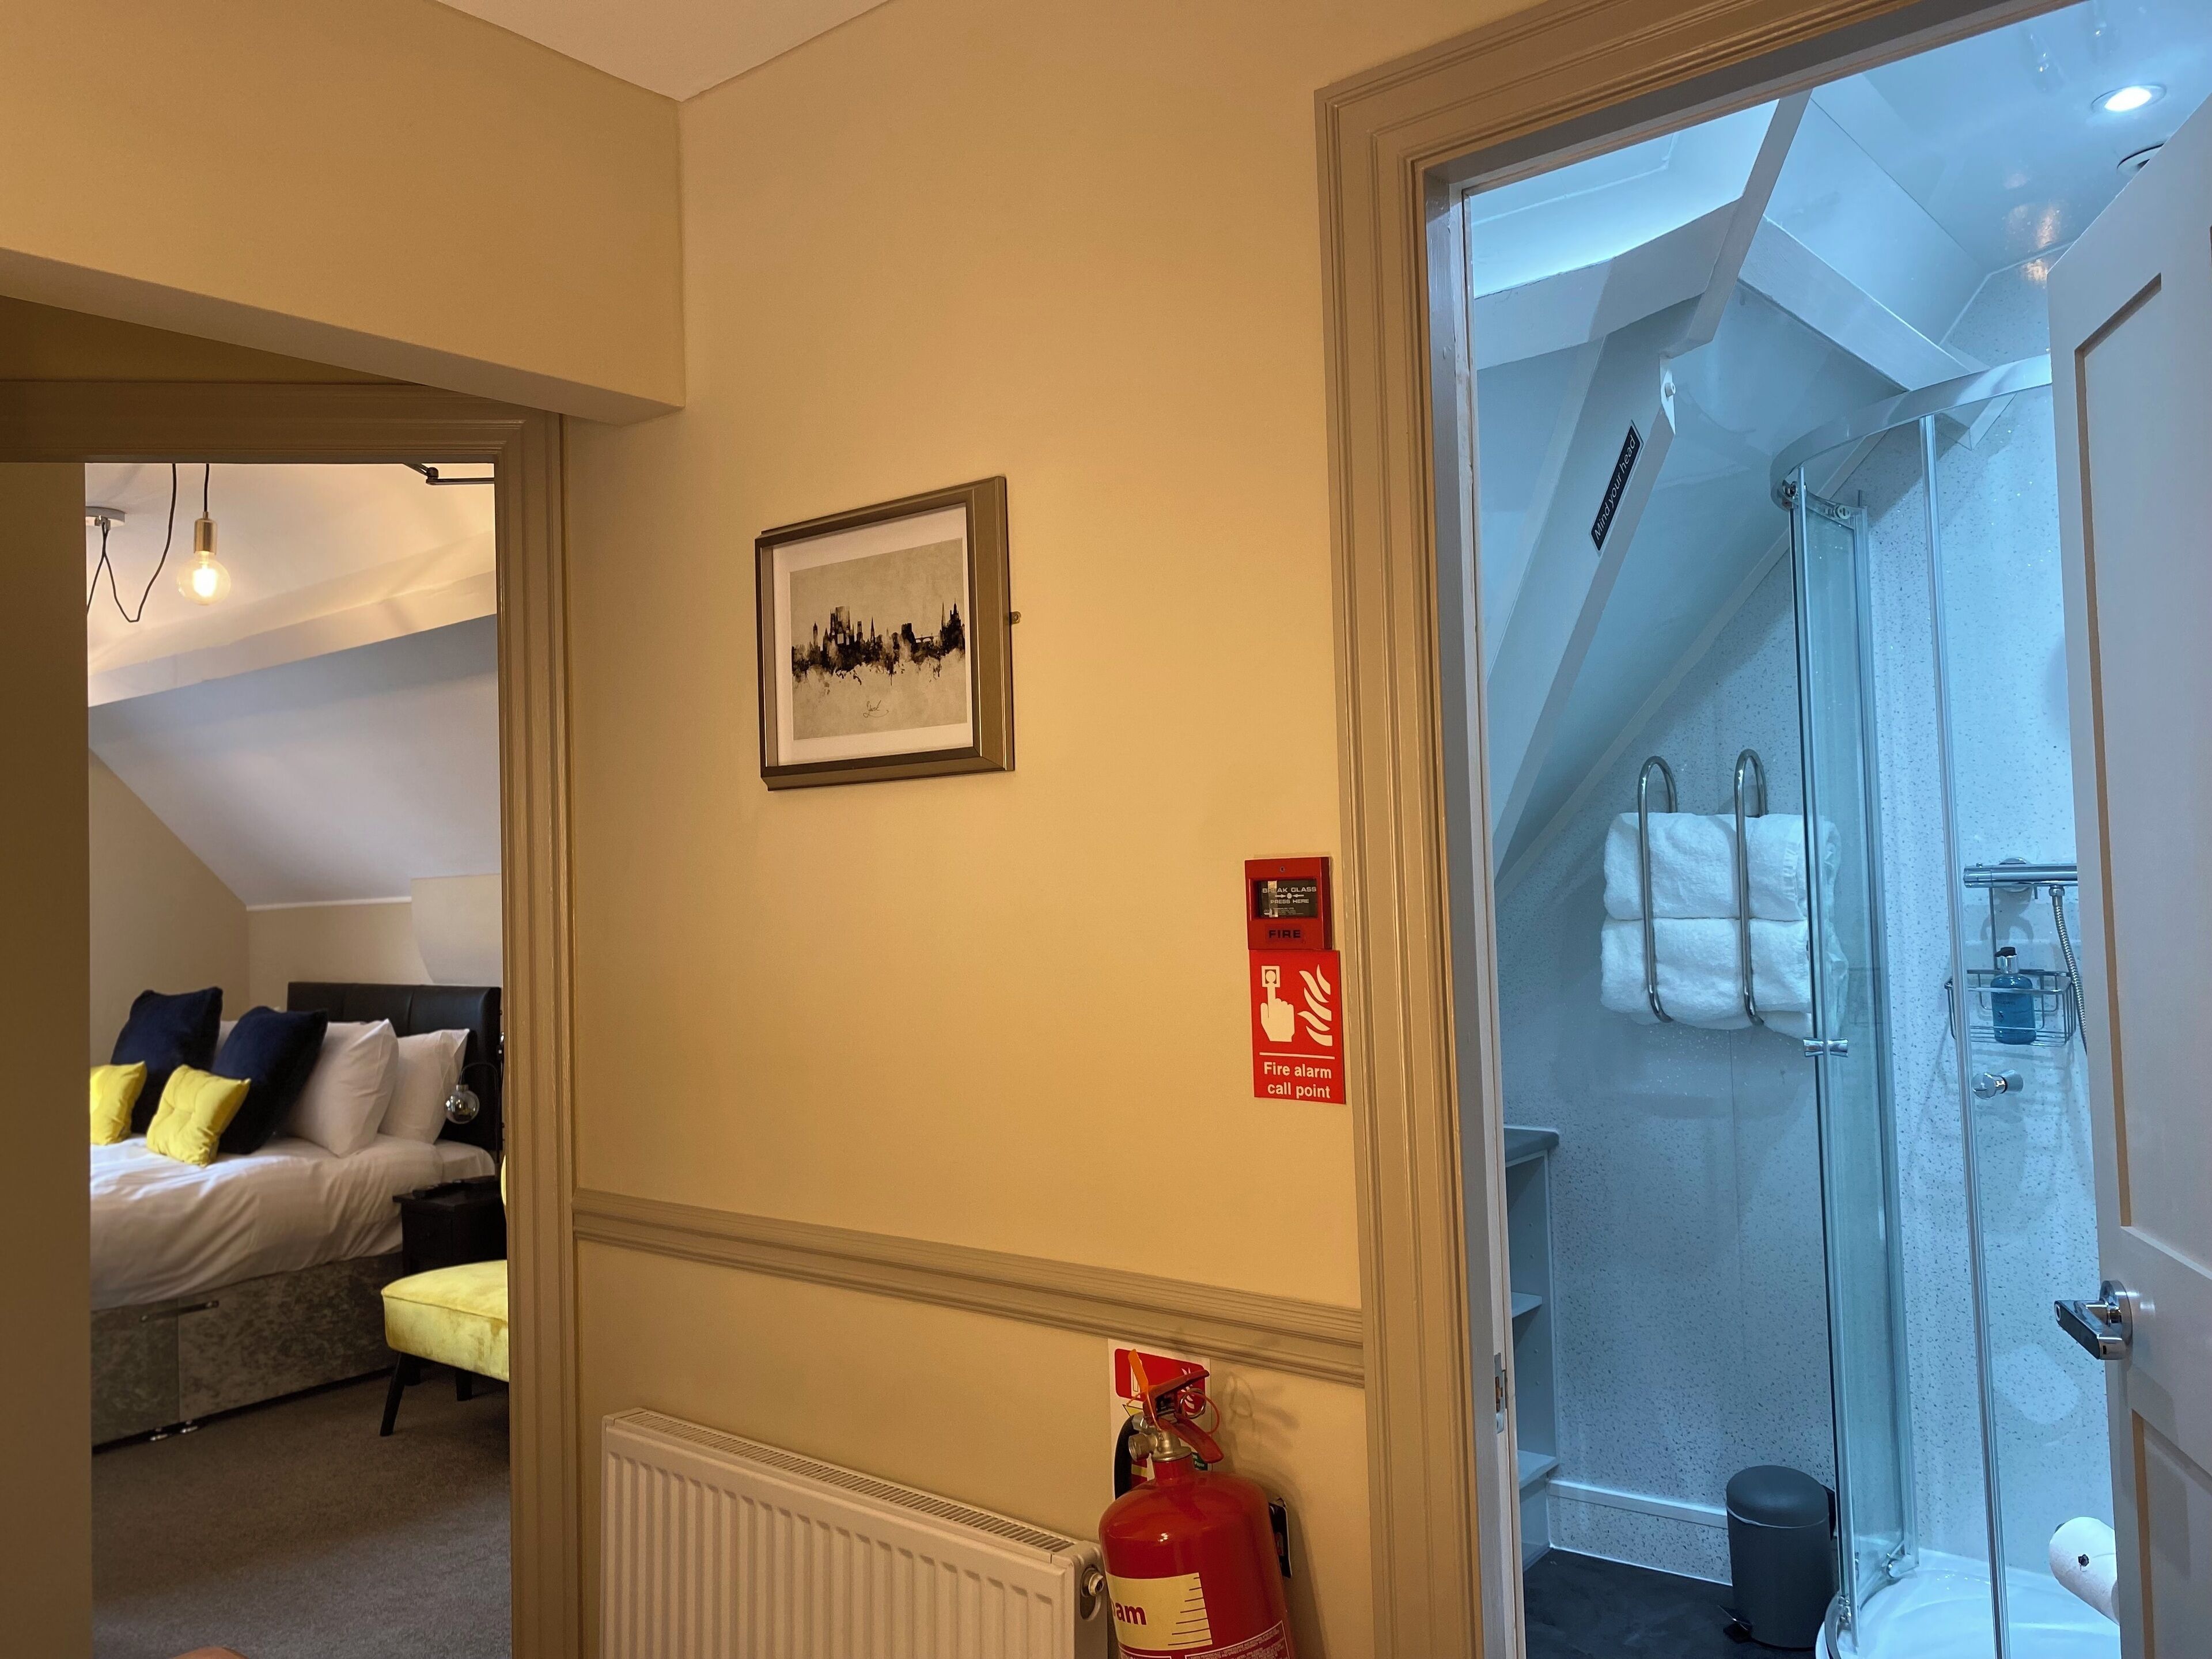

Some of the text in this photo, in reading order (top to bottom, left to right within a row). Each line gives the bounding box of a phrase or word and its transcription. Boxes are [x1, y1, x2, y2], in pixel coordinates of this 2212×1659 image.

[1594, 434, 1636, 540] Mind your head
[1269, 930, 1301, 938] FIRE
[1264, 1062, 1332, 1079] Fire alarm
[1267, 1082, 1330, 1099] call point
[1111, 1599, 1147, 1625] am
